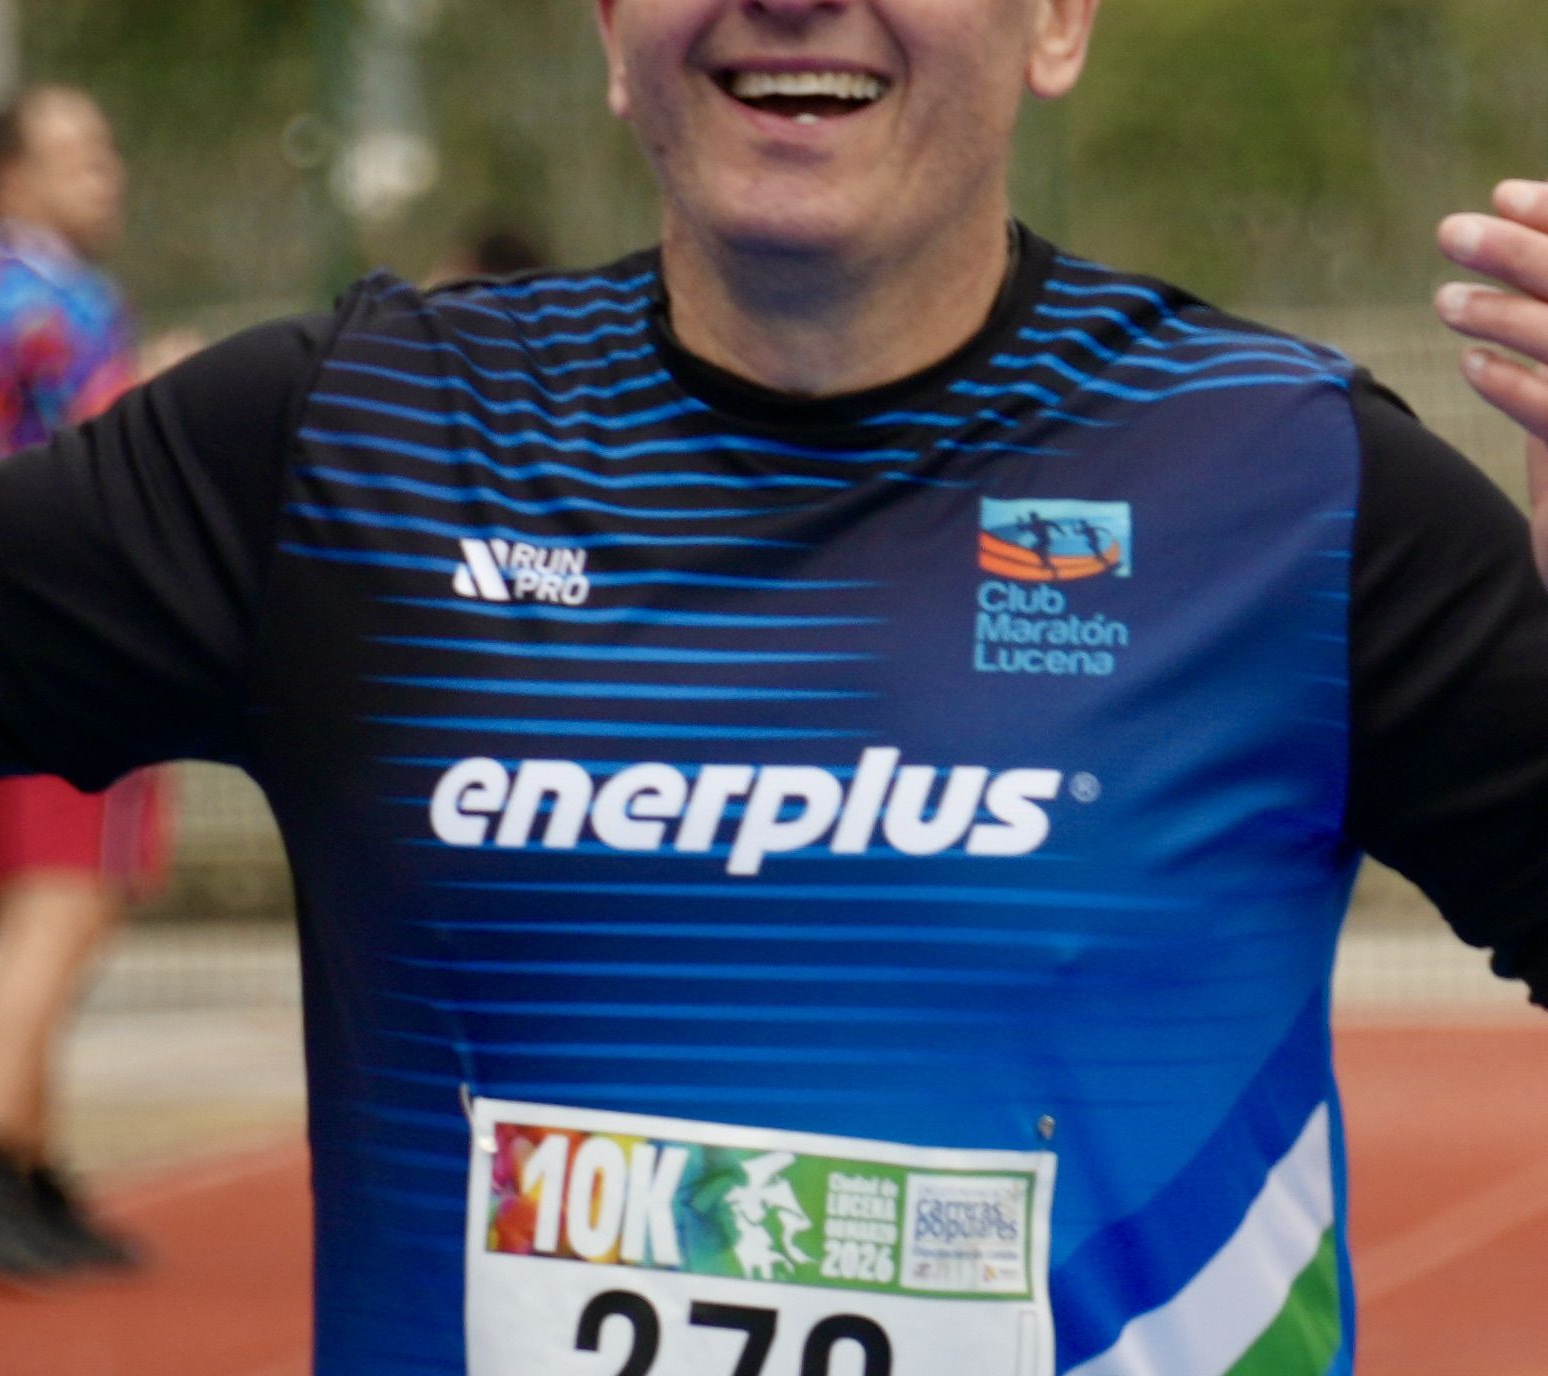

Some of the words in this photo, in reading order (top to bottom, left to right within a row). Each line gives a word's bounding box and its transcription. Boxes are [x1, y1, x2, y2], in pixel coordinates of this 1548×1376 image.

[512, 542, 587, 575] RUN
[513, 569, 590, 605] PRO
[977, 580, 1066, 615] Club
[976, 612, 1129, 646] Maratón
[974, 642, 1116, 675] Lucena
[522, 1134, 690, 1267] 10K
[821, 1239, 896, 1284] 2026
